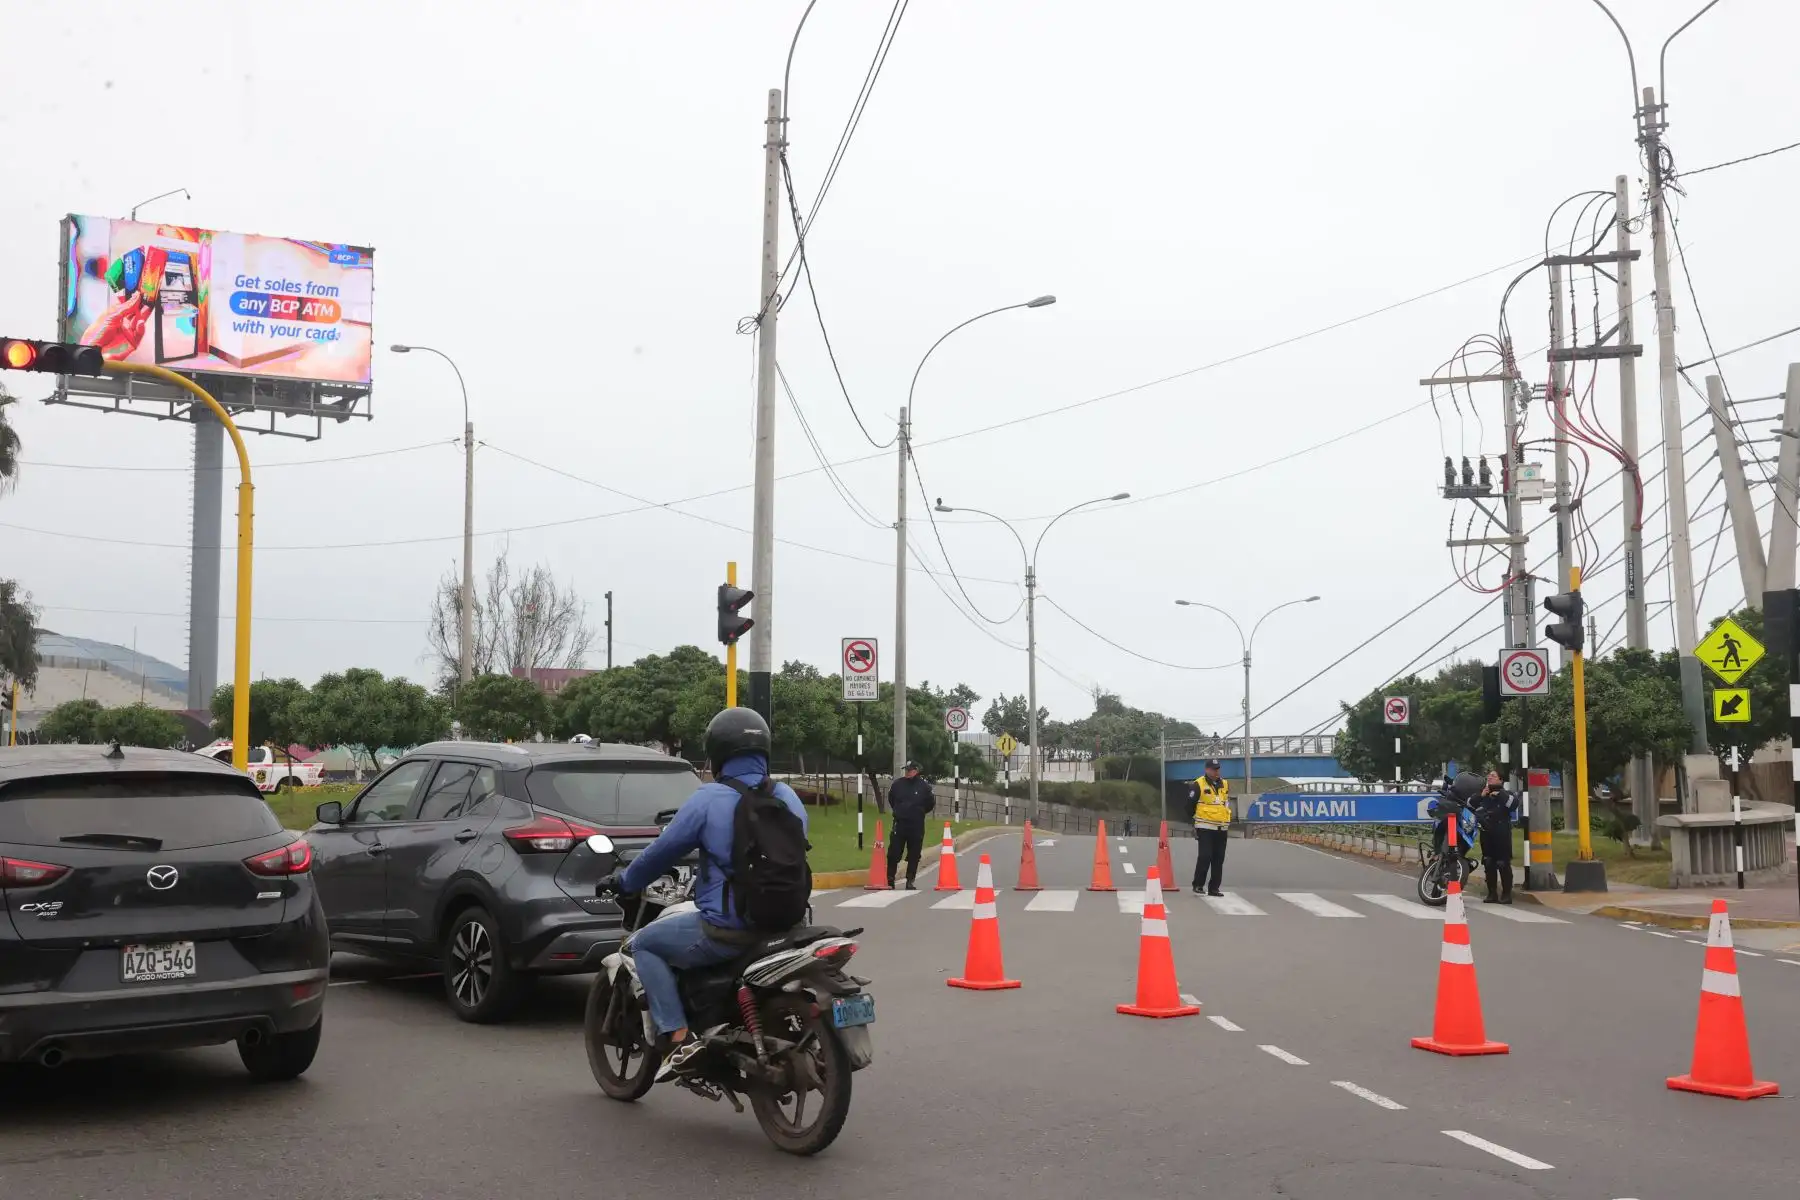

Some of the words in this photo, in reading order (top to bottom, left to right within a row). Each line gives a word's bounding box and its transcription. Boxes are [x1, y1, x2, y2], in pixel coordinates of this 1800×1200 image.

[235, 274, 261, 289] Get
[264, 278, 302, 294] soles
[306, 281, 339, 297] from
[238, 298, 267, 313] any
[270, 299, 300, 314] BCP
[302, 303, 334, 317] ATM
[233, 319, 265, 334] with
[270, 324, 302, 339] your
[1511, 661, 1539, 677] 30
[950, 713, 963, 722] 30
[1256, 800, 1356, 817] TSUNAMI
[20, 901, 63, 911] CX-3
[125, 948, 194, 974] AZQ-546
[156, 971, 185, 979] MOTORS
